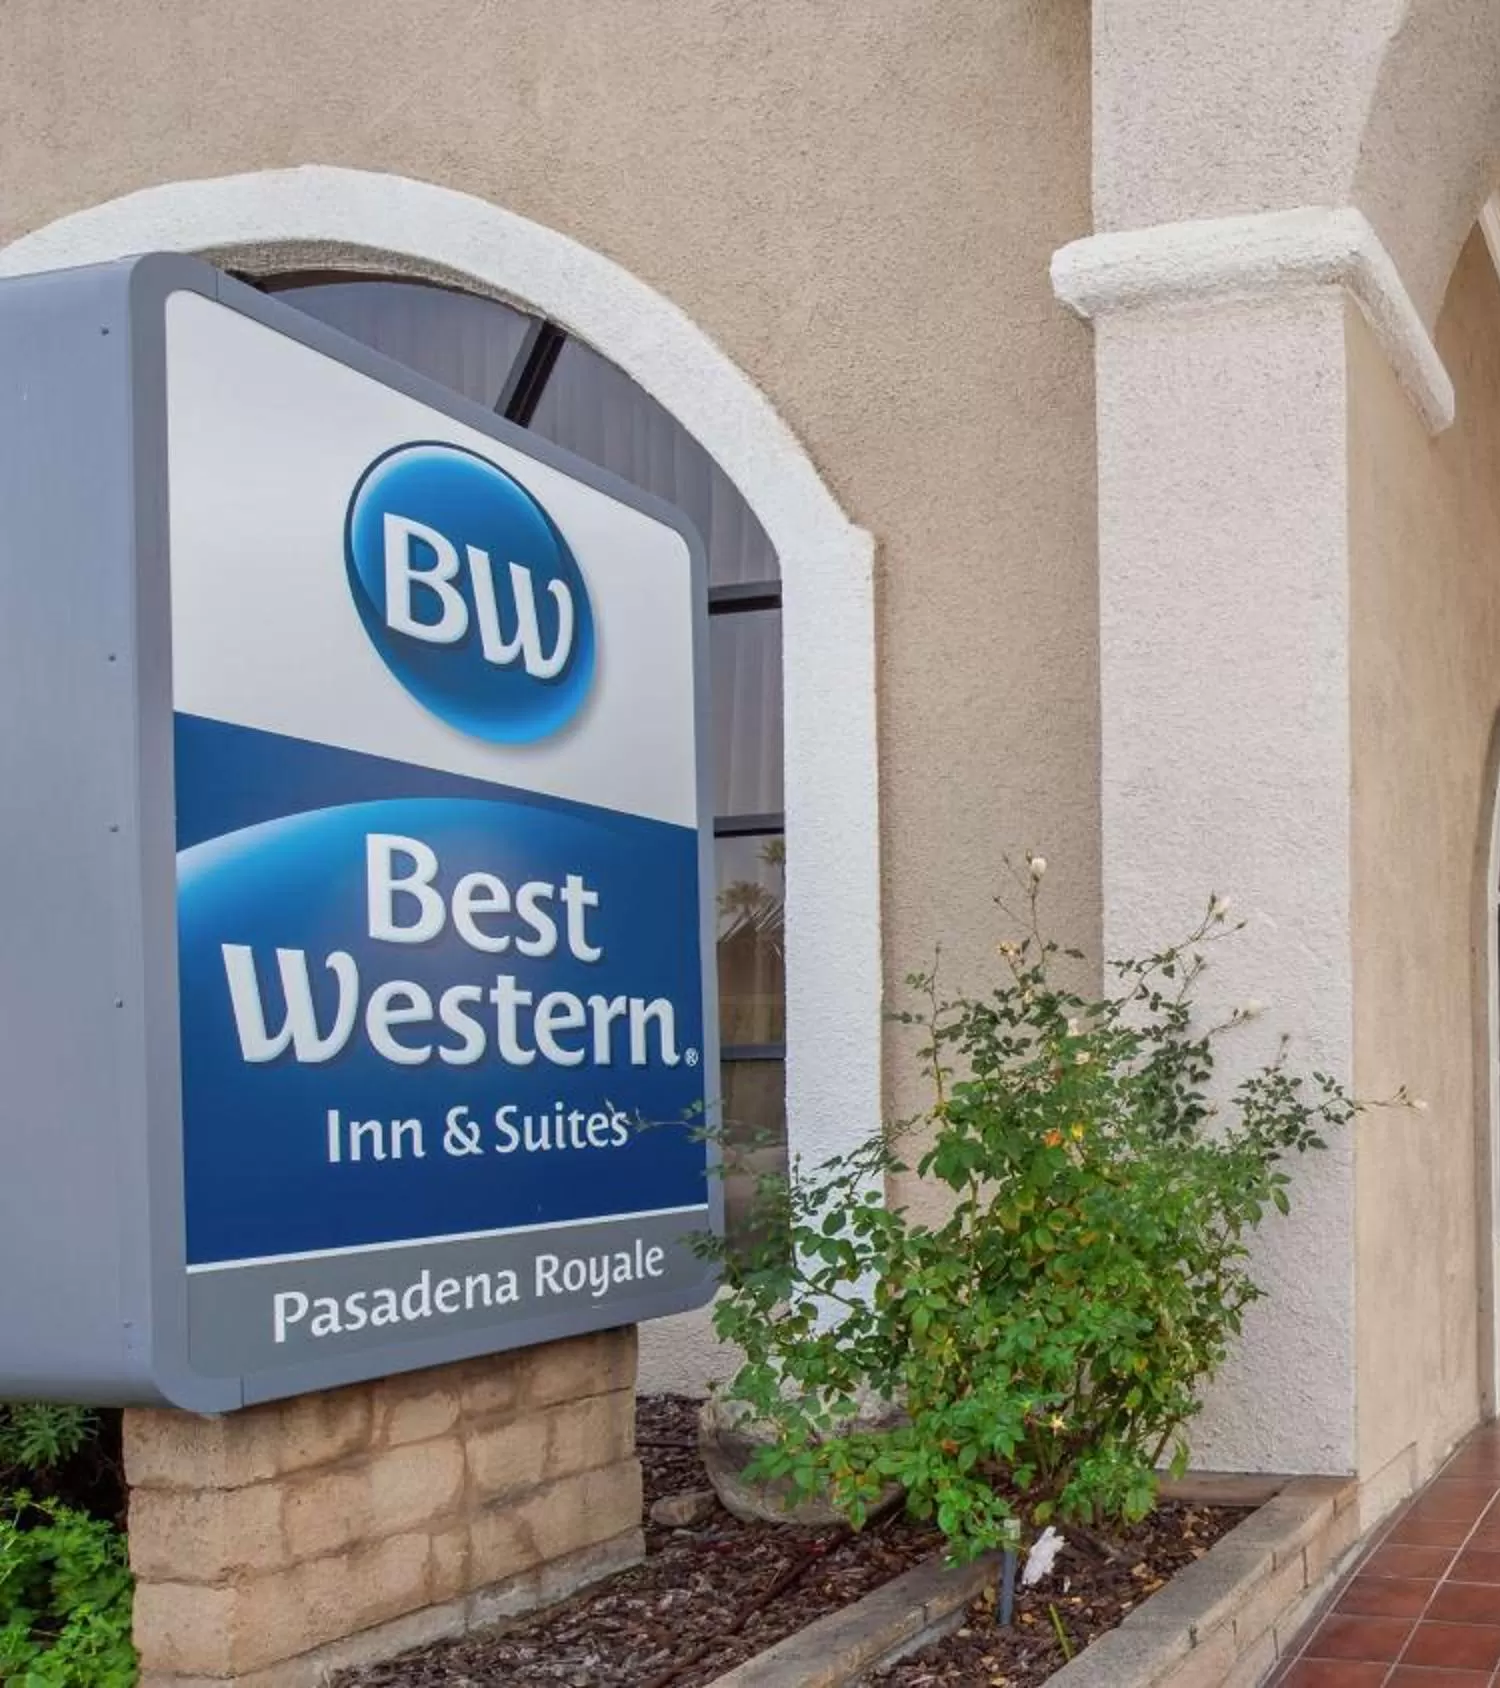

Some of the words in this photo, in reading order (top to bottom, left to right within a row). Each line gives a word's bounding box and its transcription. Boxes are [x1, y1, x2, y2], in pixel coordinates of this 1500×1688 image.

[383, 511, 575, 680] BW
[365, 832, 603, 963] Best
[326, 1108, 427, 1163] Inn
[442, 1105, 484, 1157] &
[494, 1100, 630, 1154] Suites
[272, 1268, 519, 1344] Pasadena
[534, 1238, 665, 1298] Royale
